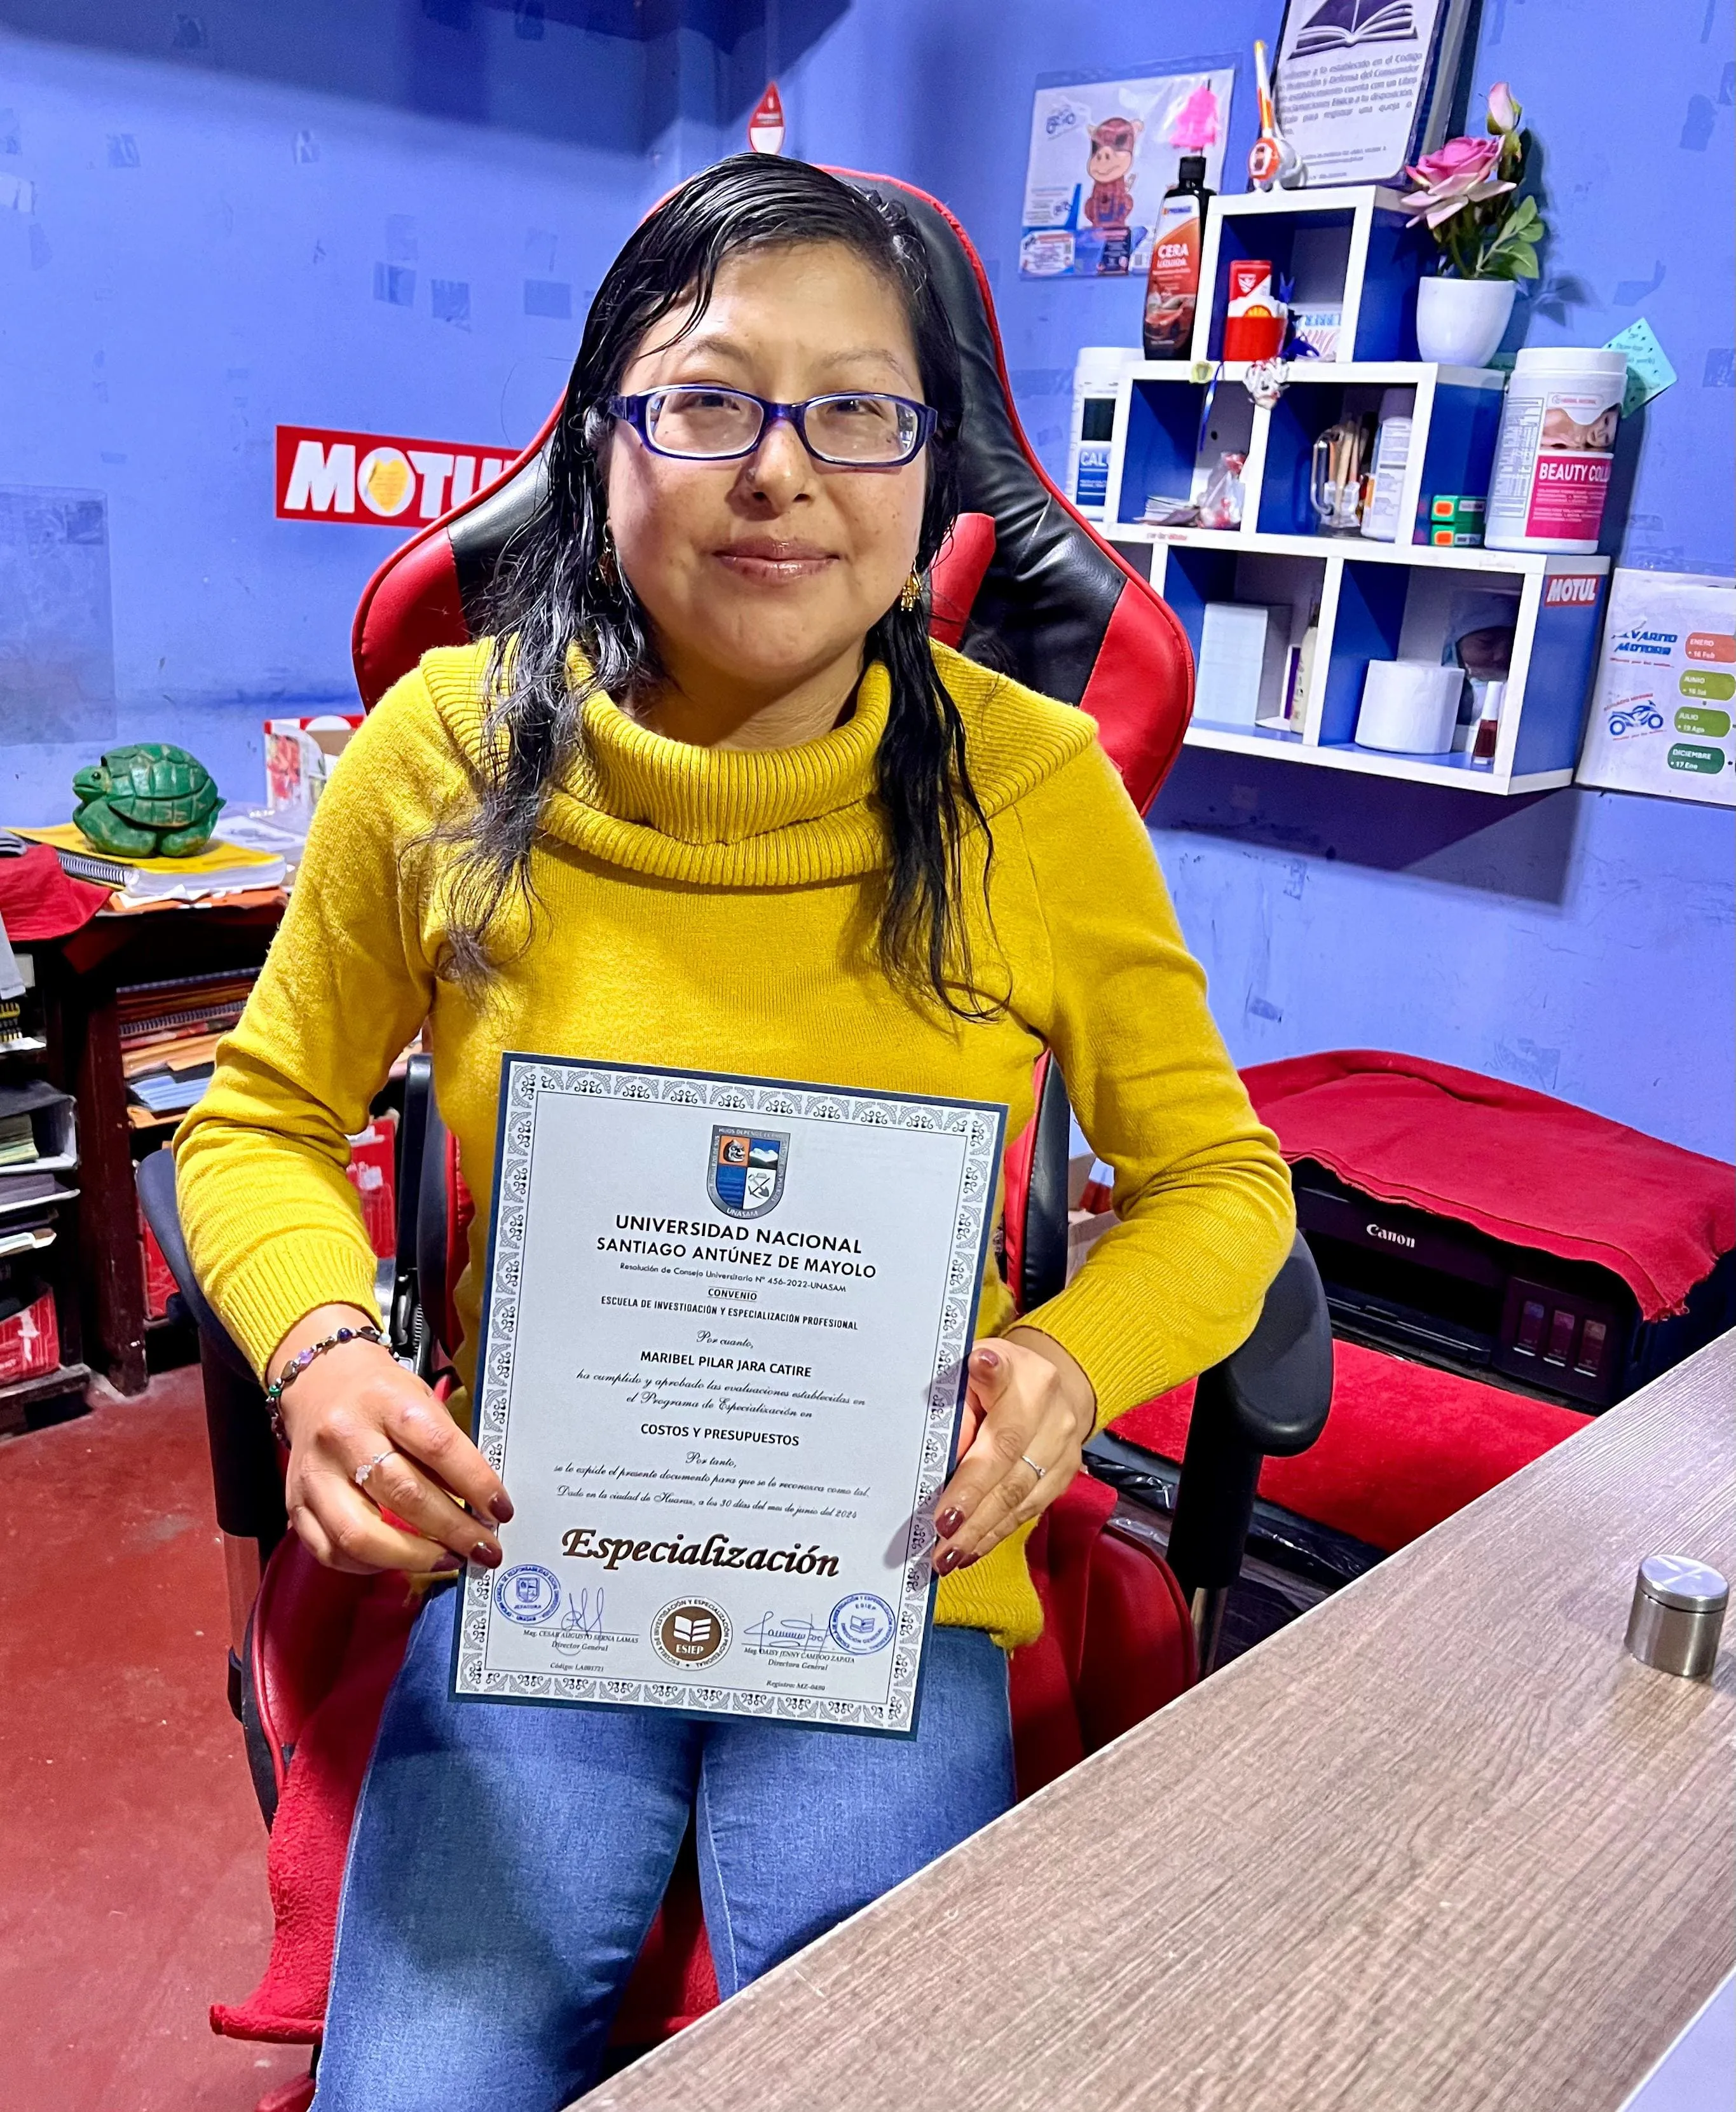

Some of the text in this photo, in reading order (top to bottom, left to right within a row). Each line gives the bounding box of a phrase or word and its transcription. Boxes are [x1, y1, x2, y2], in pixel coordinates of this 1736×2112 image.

[1157, 243, 1189, 259] CERA
[284, 440, 515, 518] MOTU
[1539, 463, 1588, 481] BEAUTY
[1547, 577, 1597, 603] MOTUL
[1672, 748, 1712, 760] DICIEMBRE
[727, 1208, 758, 1217] UNASAM
[616, 1214, 861, 1254] UNIVERSIDAD NACIONAL
[1366, 1223, 1415, 1249] Canon
[597, 1237, 876, 1278] SANTIAGO ANTÚNEZ DE MAYOLO
[620, 1262, 659, 1272] Resolución
[674, 1268, 703, 1278] Consejo
[706, 1271, 753, 1282] Universitario
[767, 1277, 846, 1293] 456-2022-UNASAM
[707, 1288, 757, 1300] CONVENIO
[601, 1296, 858, 1330] ESCUELA DE INVESTIGACIÓN Y ESPECIALIZACIÓN PROFESIONAL
[696, 1330, 754, 1349] Por cuanto,
[640, 1351, 812, 1377] MARIBEL PILAR JARA CATIRE
[576, 1368, 590, 1379] ha
[593, 1372, 641, 1386] cumplido
[642, 1379, 652, 1389] y
[655, 1377, 704, 1389] aprobado
[707, 1379, 721, 1390] las
[724, 1382, 789, 1397] evaluaciones
[791, 1390, 850, 1404] establecidas
[626, 1392, 639, 1402] el
[640, 1391, 699, 1409] Programa
[702, 1398, 714, 1408] de
[718, 1397, 797, 1416] Especialización
[641, 1423, 800, 1446] COSTOS Y PRESUPUESTOS
[685, 1451, 737, 1469] Por tanto,
[565, 1462, 573, 1472] le
[576, 1464, 606, 1478] expide
[608, 1465, 620, 1476] el
[616, 1467, 657, 1480] presente
[659, 1469, 710, 1482] documento
[709, 1474, 735, 1486] para
[738, 1478, 755, 1489] que
[779, 1481, 824, 1492] reconozca
[557, 1485, 584, 1497] Dado
[598, 1489, 607, 1498] la
[609, 1491, 641, 1501] ciudad
[640, 1491, 651, 1501] de
[706, 1497, 718, 1506] los
[720, 1499, 731, 1507] 30
[732, 1498, 750, 1509] días
[752, 1500, 768, 1509] del
[784, 1502, 795, 1512] de
[792, 1505, 818, 1517] junio
[820, 1507, 835, 1516] del
[562, 1528, 840, 1577] Especialización
[552, 1640, 608, 1652] Director General
[560, 1632, 592, 1640] AUGUSTO
[676, 1644, 704, 1654] ESIEP
[768, 1658, 828, 1671] Directora General
[766, 1680, 795, 1689] Registro:
